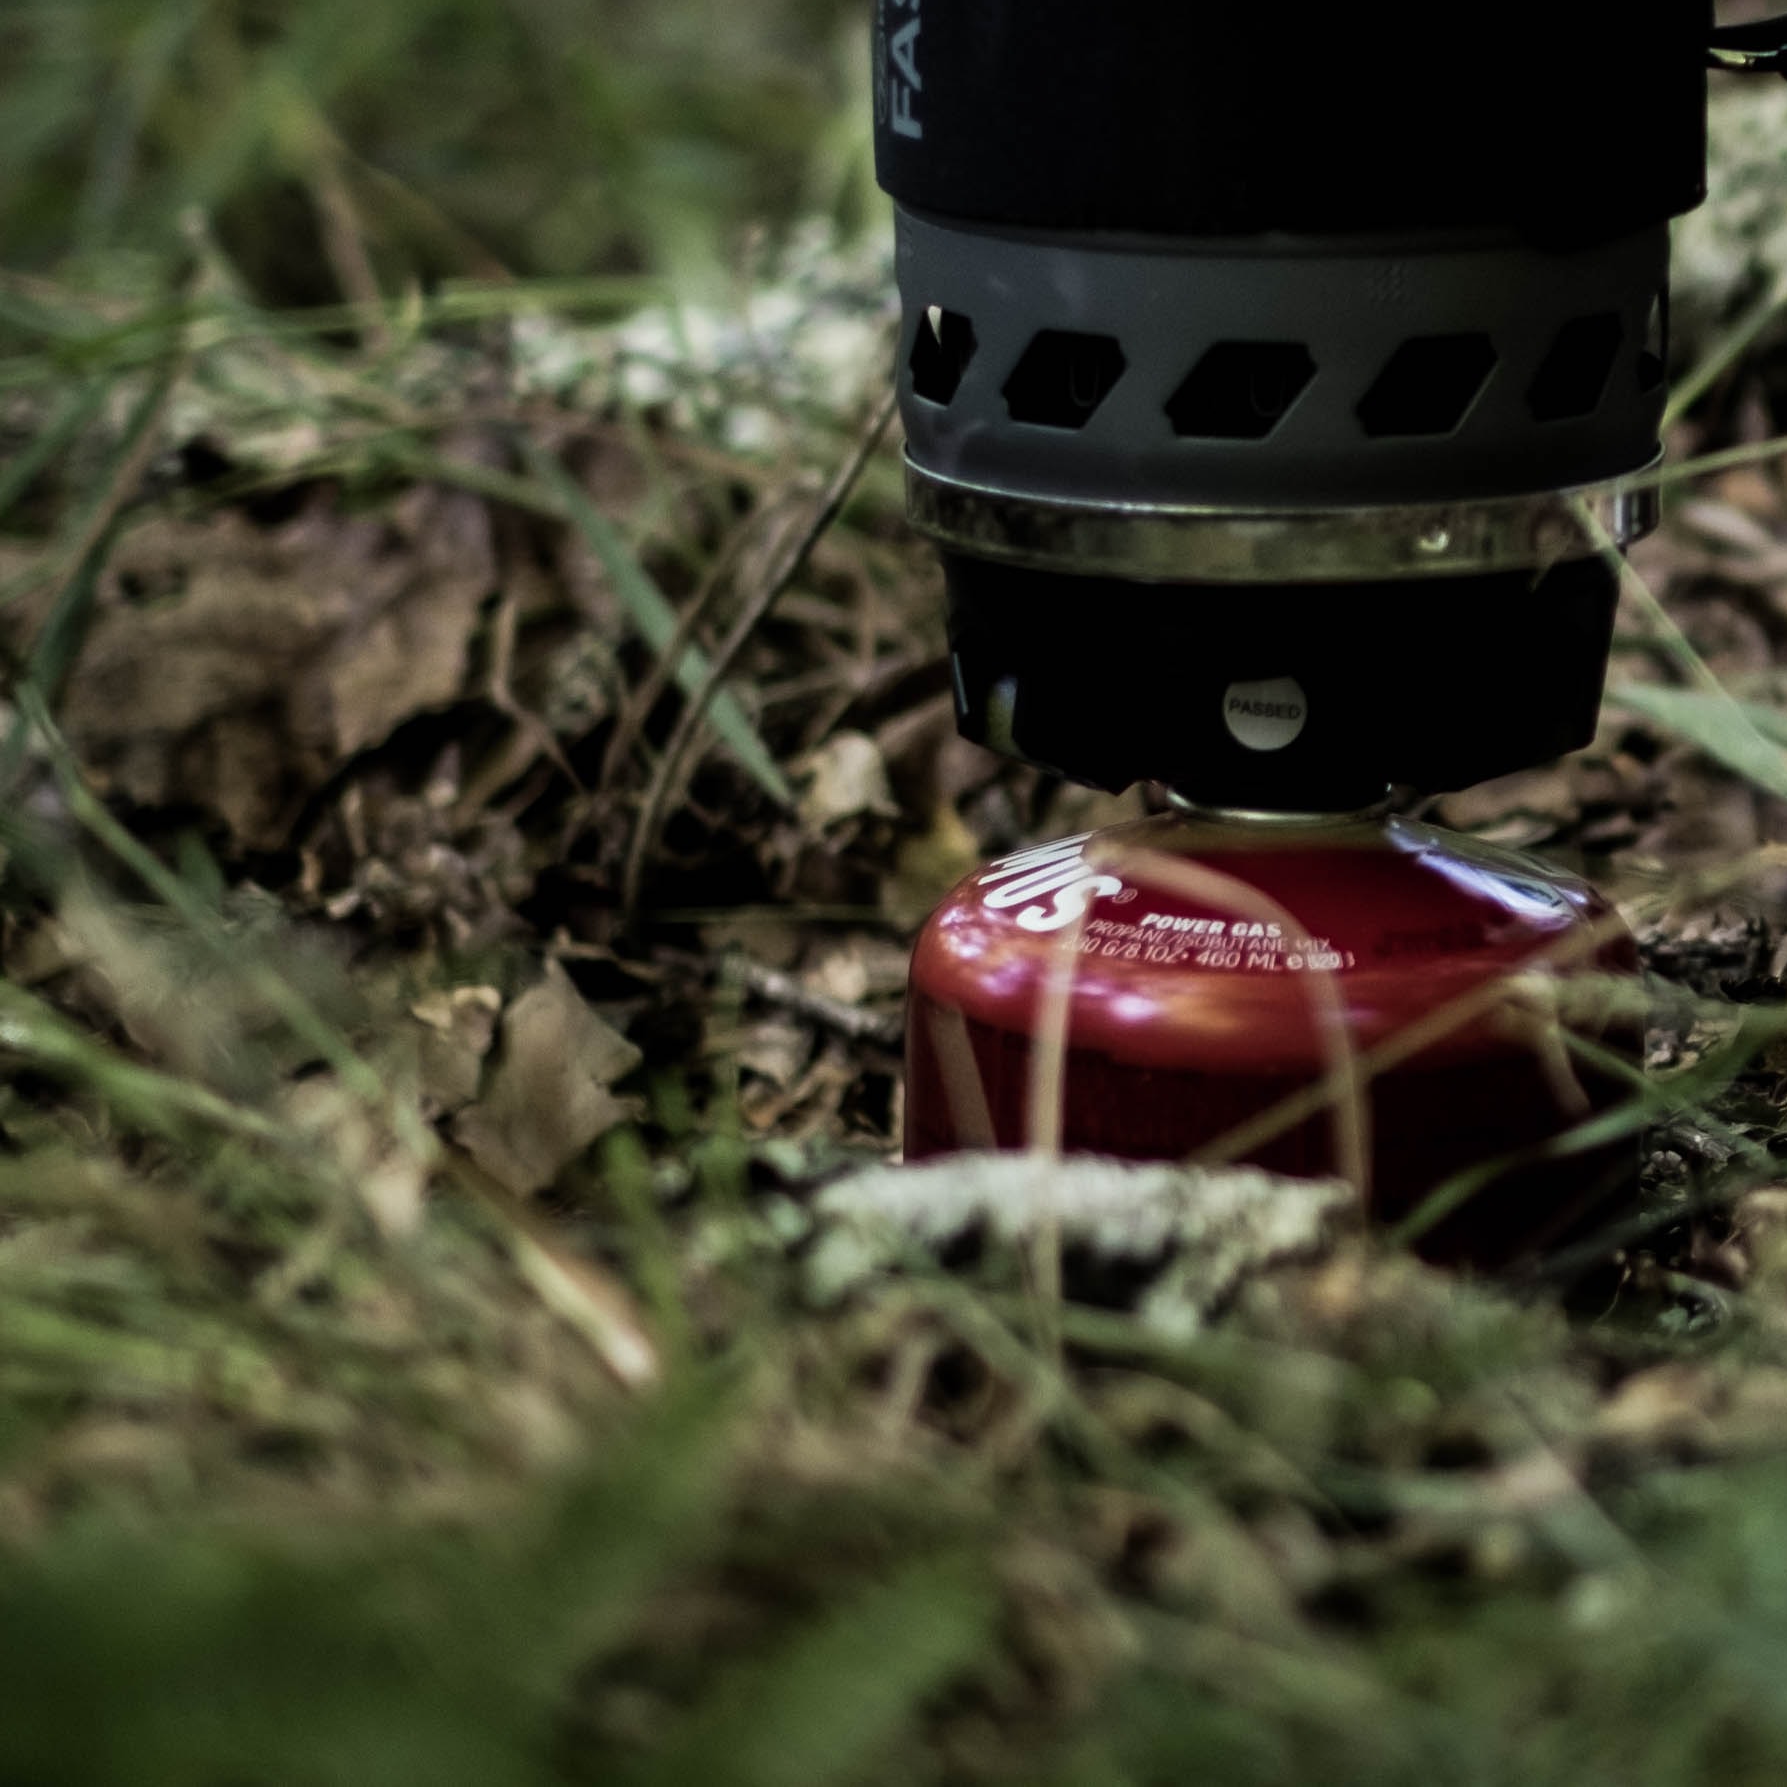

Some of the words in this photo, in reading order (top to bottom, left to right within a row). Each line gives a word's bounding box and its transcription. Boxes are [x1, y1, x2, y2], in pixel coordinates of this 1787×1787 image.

[1228, 698, 1303, 720] PASSED
[1140, 913, 1226, 934] POWER
[1231, 923, 1282, 938] GAS
